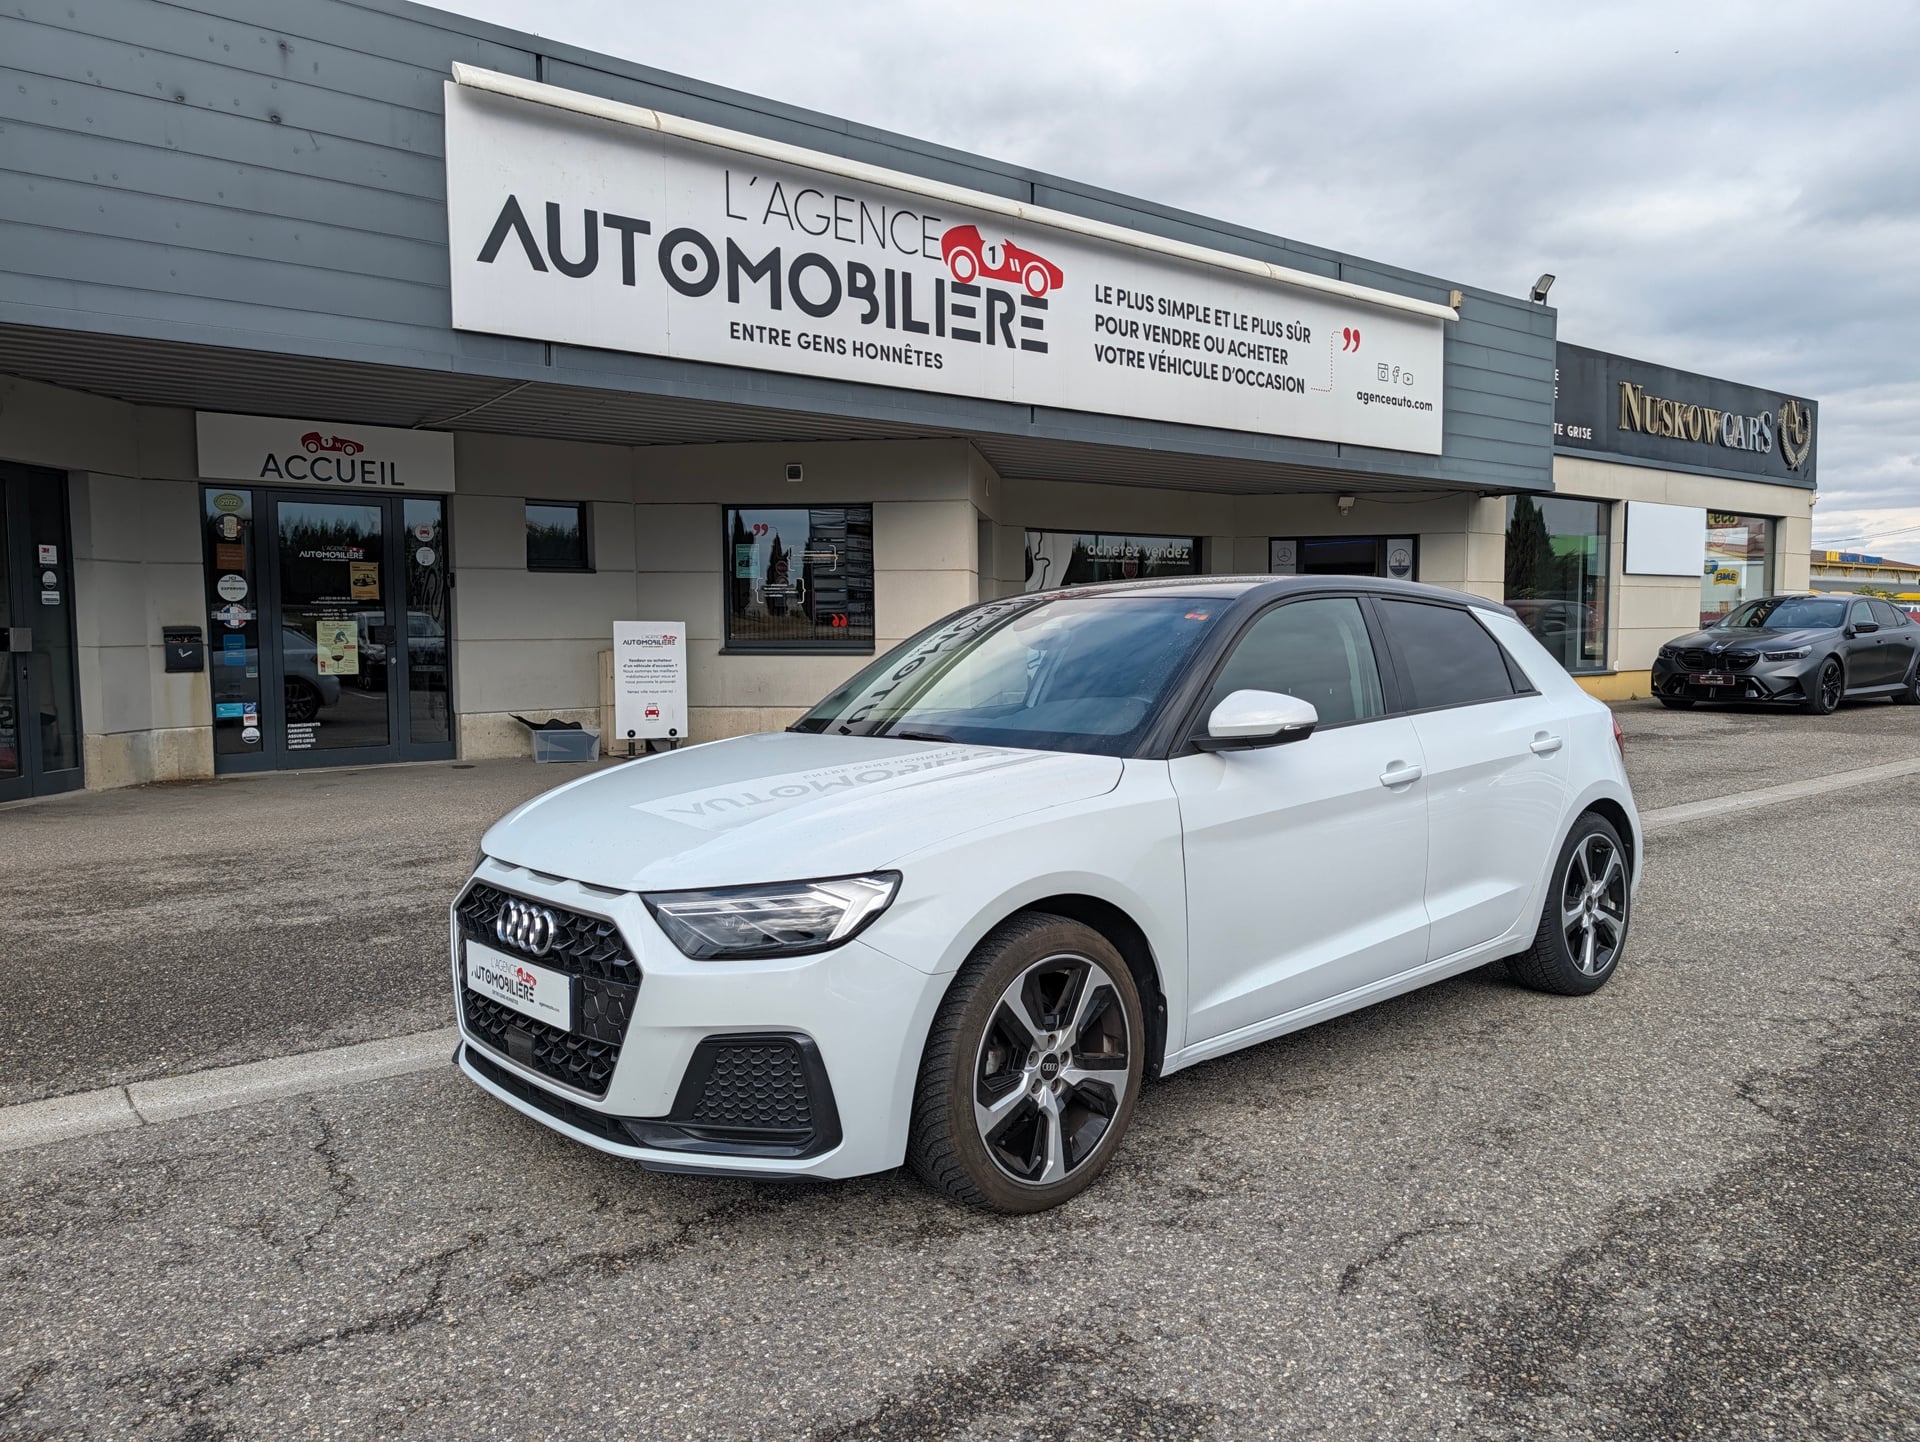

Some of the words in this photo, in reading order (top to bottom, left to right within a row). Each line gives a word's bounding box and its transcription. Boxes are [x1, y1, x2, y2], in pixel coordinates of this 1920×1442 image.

[725, 170, 942, 260] L'AGENCE
[1095, 284, 1112, 305] LE
[1117, 289, 1154, 313] PLUS
[1158, 297, 1211, 324] SIMPLE
[1215, 309, 1231, 328] ET
[1233, 312, 1249, 332] LE
[1251, 316, 1284, 339] PLUS
[1286, 320, 1311, 344] SÛR
[730, 321, 791, 347] ENTRE
[797, 332, 847, 355] GENS
[853, 340, 943, 369] HONNÊTES
[1095, 314, 1140, 339] POUR
[1142, 323, 1200, 349] VENDRE
[1204, 334, 1225, 354] OU
[1227, 338, 1288, 365] ACHETER
[1094, 344, 1146, 369] VOTRE
[1148, 350, 1219, 382] VÉHICULE
[1222, 367, 1305, 394] D'OCCASION
[1356, 391, 1433, 411] agenceauto.com
[1567, 426, 1592, 439] GRISE
[260, 453, 404, 486] ACCUEIL
[1087, 540, 1140, 557] achetez
[1145, 541, 1189, 559] vendez
